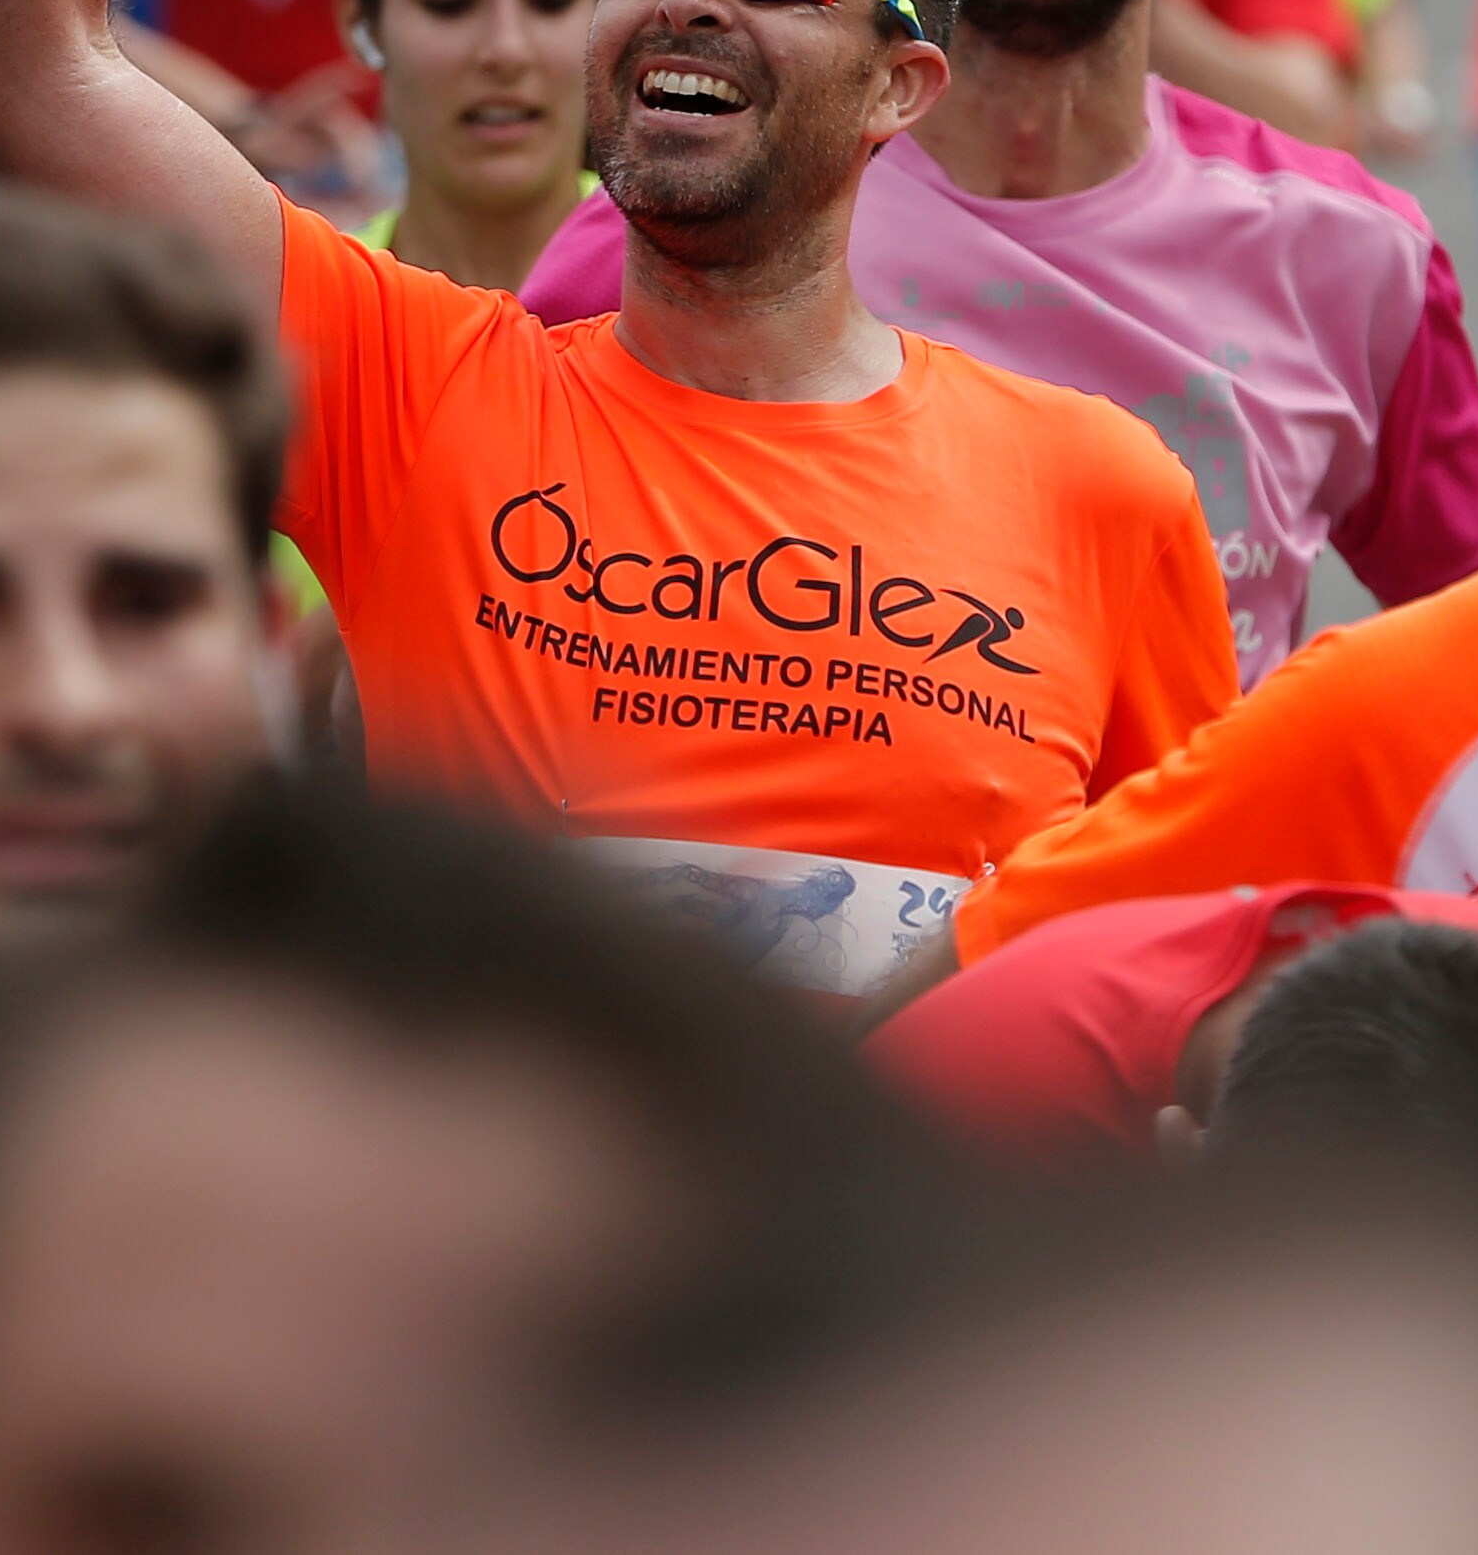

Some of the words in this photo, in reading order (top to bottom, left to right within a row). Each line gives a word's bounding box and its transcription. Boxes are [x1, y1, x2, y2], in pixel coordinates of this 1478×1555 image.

[474, 593, 813, 689] ENTRENAMIENTO
[826, 659, 1036, 744] PERSONAL
[592, 688, 893, 747] FISIOTERAPIA
[898, 879, 954, 928] 24
